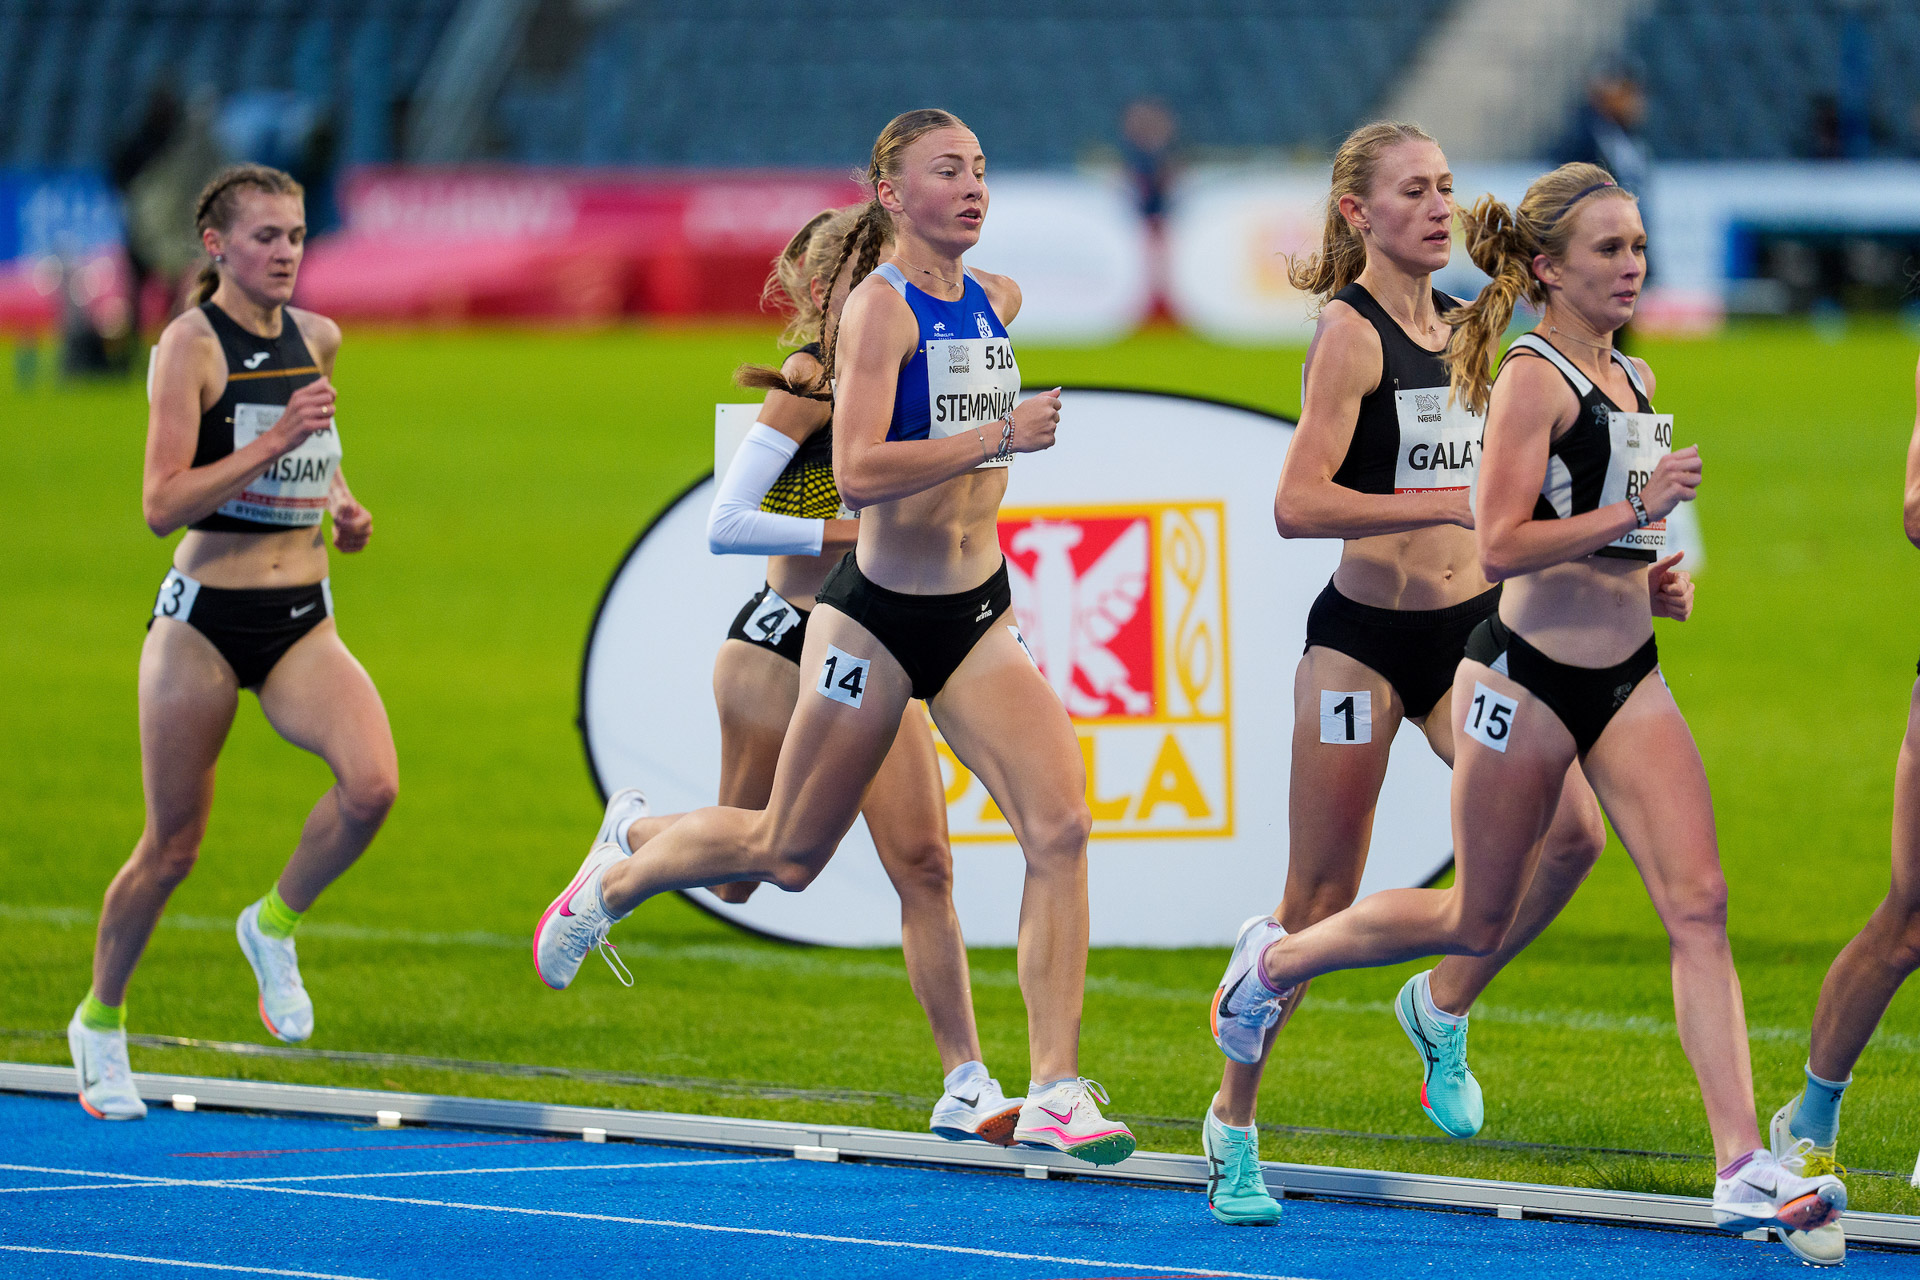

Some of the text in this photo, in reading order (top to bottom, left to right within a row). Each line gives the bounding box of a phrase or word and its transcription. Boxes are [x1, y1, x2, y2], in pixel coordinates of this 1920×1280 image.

[985, 344, 1013, 370] 516
[936, 391, 1016, 422] STEMPNIAK
[1654, 422, 1672, 449] 40
[263, 456, 330, 482] ISJAN
[1408, 440, 1483, 471] GALA
[163, 578, 185, 617] 3
[756, 607, 789, 636] 4
[824, 655, 863, 699] 14
[1334, 696, 1355, 741] 1
[1473, 694, 1512, 741] 15
